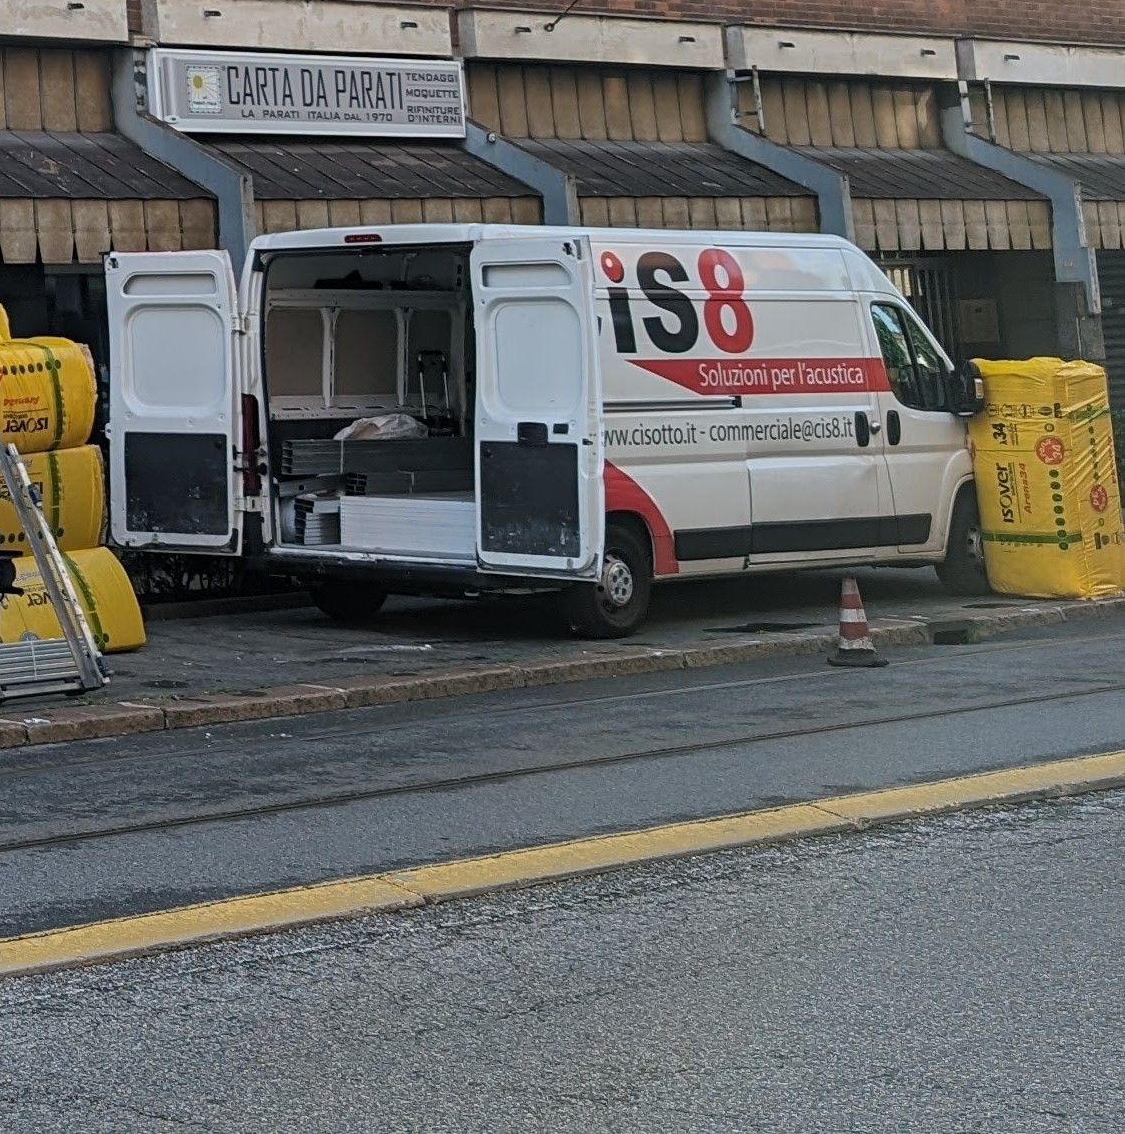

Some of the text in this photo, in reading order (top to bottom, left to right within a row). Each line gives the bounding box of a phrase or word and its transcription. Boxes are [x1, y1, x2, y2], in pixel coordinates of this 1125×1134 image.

[405, 73, 458, 83] TENDAGGI
[227, 66, 403, 109] CARTA DA PARATI
[406, 88, 459, 99] MOQUETTE
[241, 109, 393, 122] LA PARATI ITALIA DAL 1970
[407, 106, 460, 115] RIFINITURE
[408, 114, 461, 124] D'INTERNI
[597, 248, 754, 353] iS8
[699, 362, 864, 391] Soluzioni per l'acustica
[603, 422, 698, 447] ww.cisotto.it
[709, 416, 854, 442] commerciale@cis8.it
